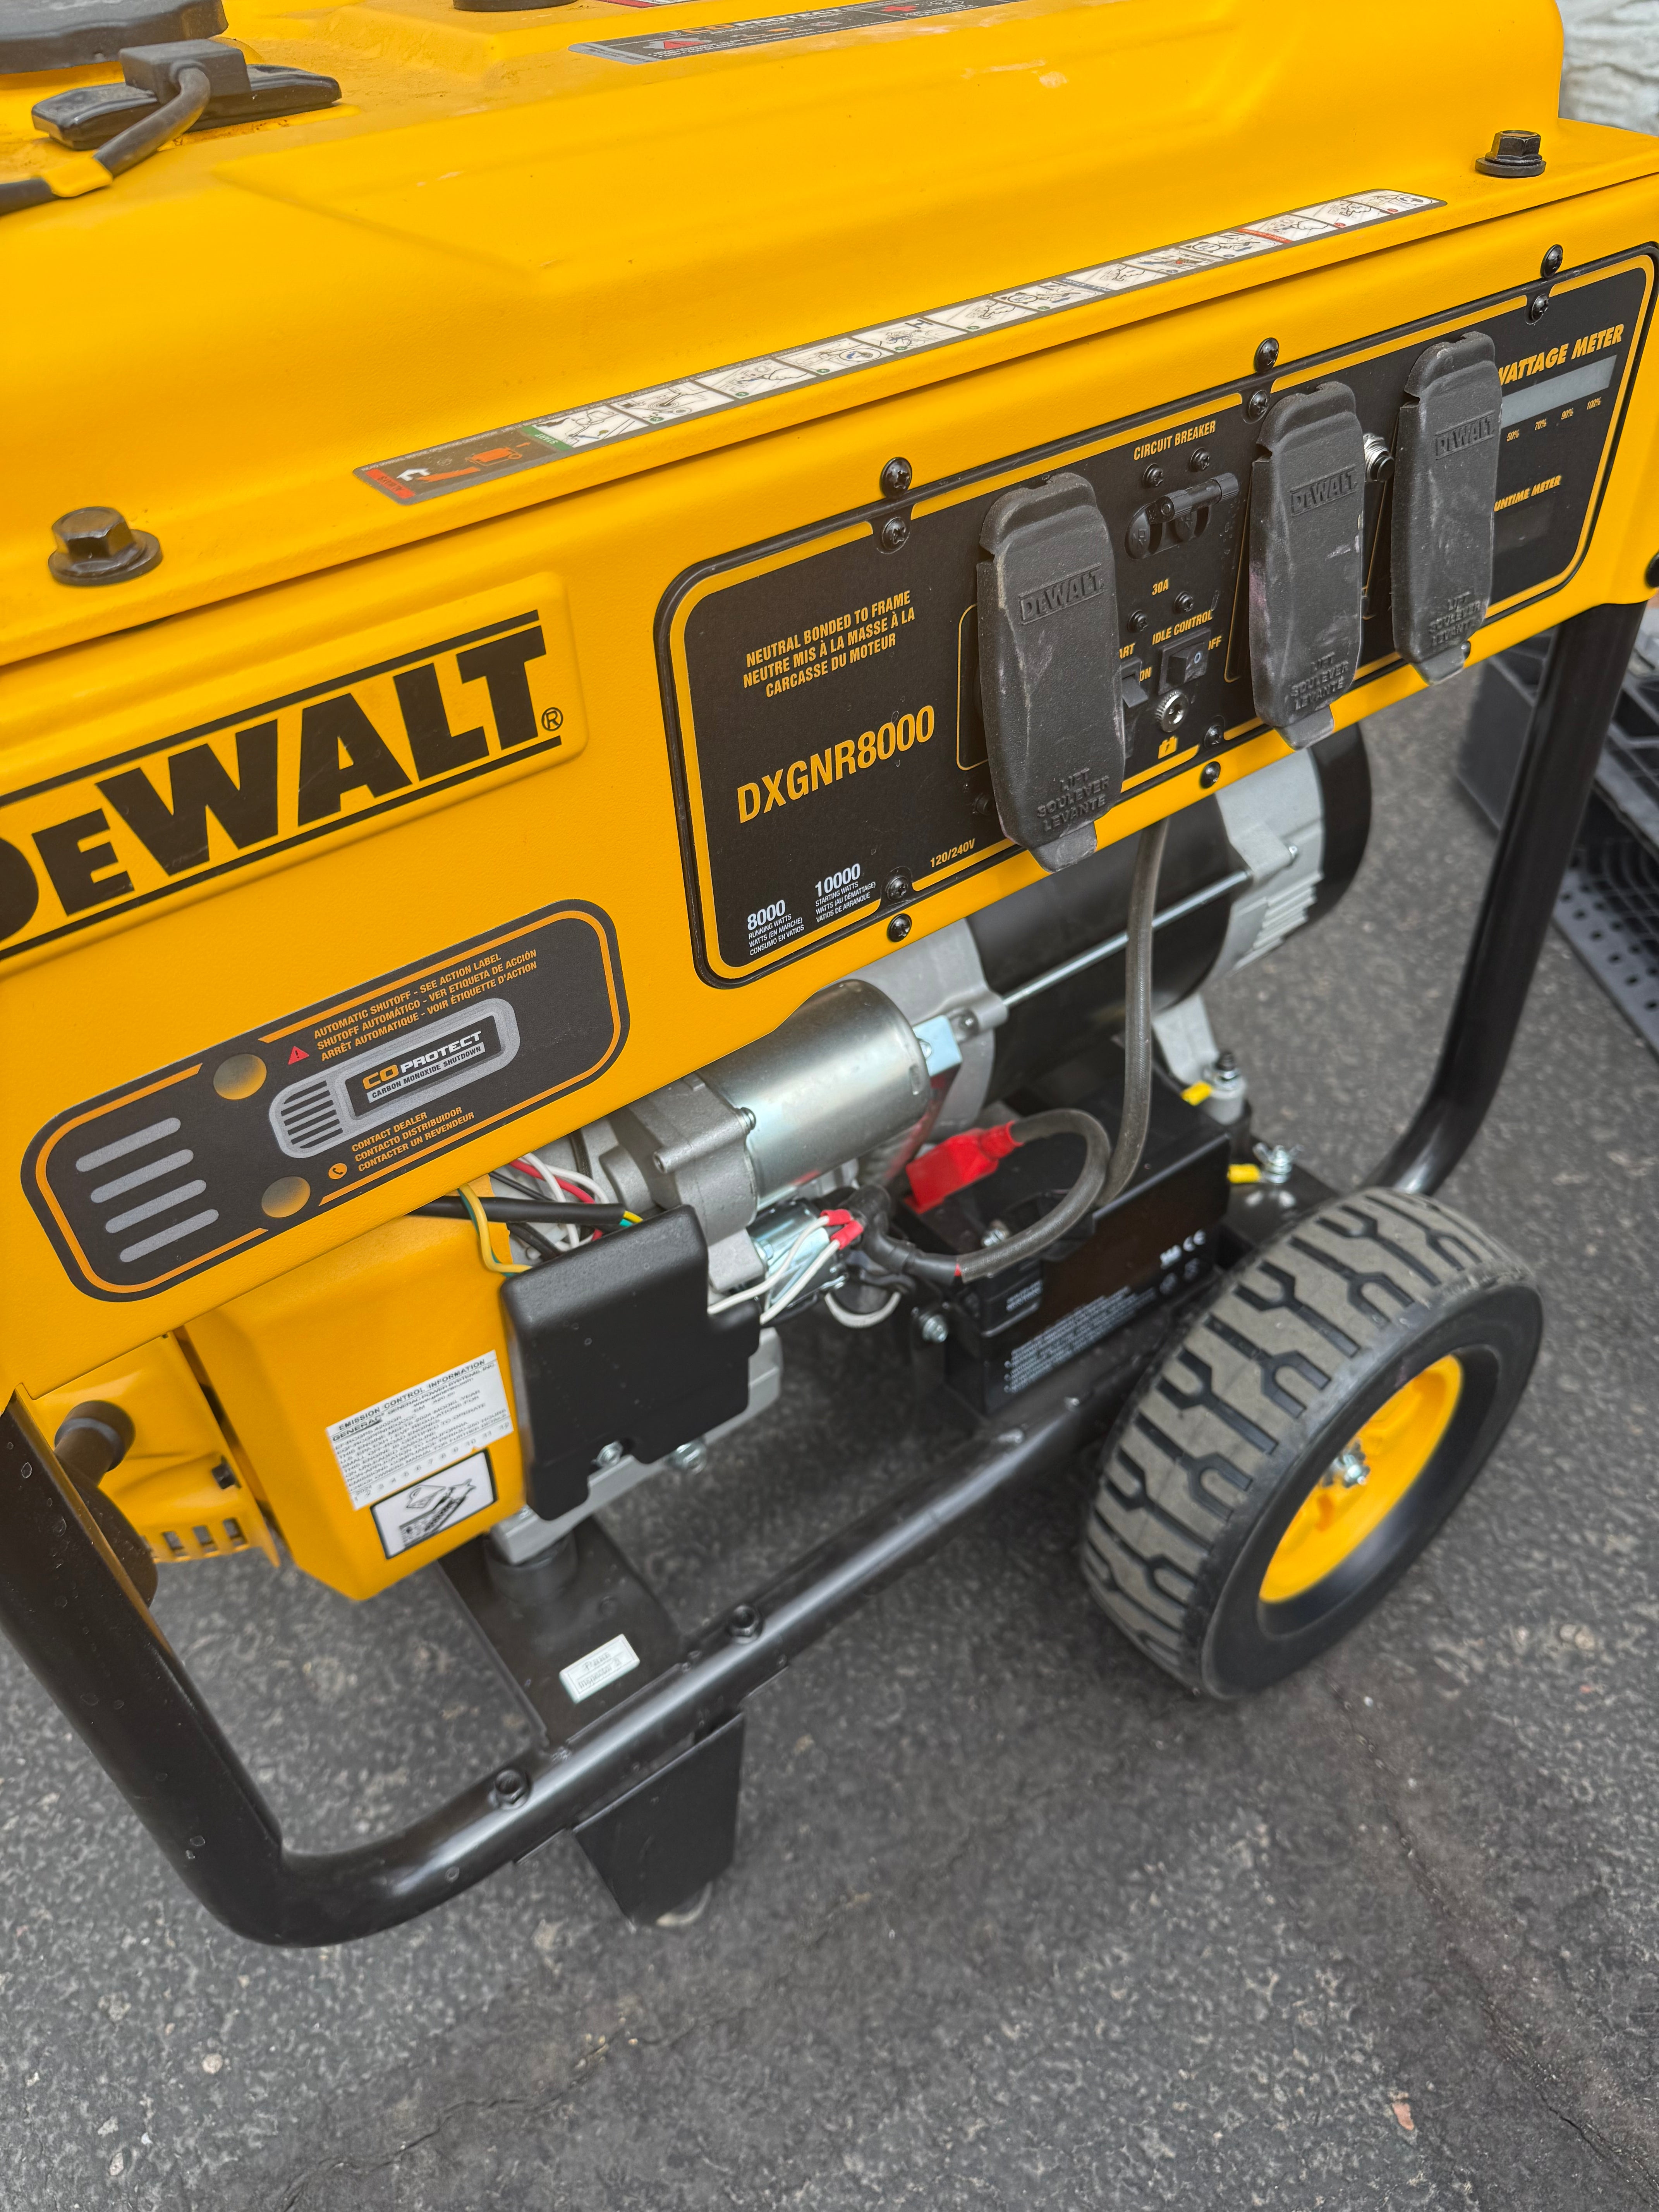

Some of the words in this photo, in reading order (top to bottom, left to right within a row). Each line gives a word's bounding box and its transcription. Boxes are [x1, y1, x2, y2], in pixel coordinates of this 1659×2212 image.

[1571, 324, 1624, 361] METER
[1561, 408, 1574, 421] 90%
[1587, 397, 1602, 410] 100%
[1133, 436, 1172, 460] CIRCUIT
[1175, 420, 1216, 447] BREAKER
[1507, 430, 1520, 442] 50%
[1535, 418, 1547, 431] 70%
[1494, 488, 1530, 512] UNTIME
[1531, 475, 1561, 497] METER
[1152, 579, 1169, 596] 30A
[746, 635, 800, 667] NEUTRAL
[804, 614, 851, 644] BONDED
[855, 607, 868, 624] TO
[872, 591, 910, 617] FRAME
[1152, 627, 1171, 645] IDLE
[1174, 610, 1213, 635] CONTROL
[1209, 635, 1223, 651] FF
[744, 658, 790, 688] NEUTRE
[793, 647, 816, 668] MIS
[819, 640, 827, 658] À
[831, 636, 844, 653] LA
[848, 618, 888, 645] MASSE
[891, 611, 898, 629] À
[902, 607, 915, 624] LA
[766, 660, 828, 697] CARCASSE
[831, 653, 847, 671] DU
[850, 633, 896, 663] MOTEUR
[737, 705, 934, 824] DXGNR8000
[1060, 768, 1090, 791] LIFT
[1037, 776, 1109, 818] SOULEVER
[1043, 795, 1106, 831] LEVANTE
[930, 838, 975, 868] 120/240V
[815, 863, 860, 897] 10000
[815, 890, 840, 907] STARTING
[841, 881, 858, 894] WATTS
[747, 900, 785, 930] 8000
[816, 902, 833, 915] WATTS
[835, 897, 843, 907] (AU
[816, 910, 834, 923] VATIOS
[835, 906, 842, 914] DE
[843, 892, 870, 910] ARRANQUE
[749, 923, 773, 939] RUNNING
[773, 914, 792, 927] WATTS
[749, 934, 768, 948] WATTS
[768, 929, 778, 939] (EN
[779, 917, 802, 933] MARCHE)
[750, 938, 777, 955] CONSUMO
[778, 934, 786, 942] EN
[786, 924, 804, 938] VATIOS
[314, 1009, 369, 1039] AUTOMATIC
[370, 991, 411, 1017] SHUTOFF
[419, 980, 438, 994] SEE
[440, 966, 472, 985] ACTION
[473, 953, 501, 971] LABEL
[317, 1024, 360, 1050] SHUTOFF
[362, 1000, 421, 1032] AUTOMÁTICO
[429, 989, 447, 1003] VER
[449, 972, 490, 996] ETIQUETA
[491, 965, 503, 977] DE
[505, 949, 537, 971] ACCIÓN
[321, 1039, 352, 1061] ARRÊT
[355, 1013, 419, 1047] AUTOMATIQUE
[427, 1000, 449, 1015] VOIR
[450, 980, 496, 1005] ÉTIQUETTE
[498, 961, 537, 985] D'ACTION
[362, 1064, 399, 1089] CO
[400, 1030, 481, 1073] PROTECT
[372, 1081, 401, 1099] CARBON
[403, 1064, 441, 1085] MONOXIDE
[443, 1046, 481, 1068] SHUTDOWN
[352, 1128, 391, 1152] CONTACT
[393, 1112, 428, 1135] DEALER
[355, 1135, 400, 1162] CONTACTO
[402, 1106, 462, 1142] DISTRIBUIDOR
[358, 1144, 409, 1171] CONTACTER
[410, 1138, 423, 1151] UN
[424, 1111, 474, 1144] REVENDEUR
[338, 1407, 380, 1431] EMISSION
[383, 1386, 425, 1410] CONTROL
[428, 1358, 484, 1389] INFORMATION
